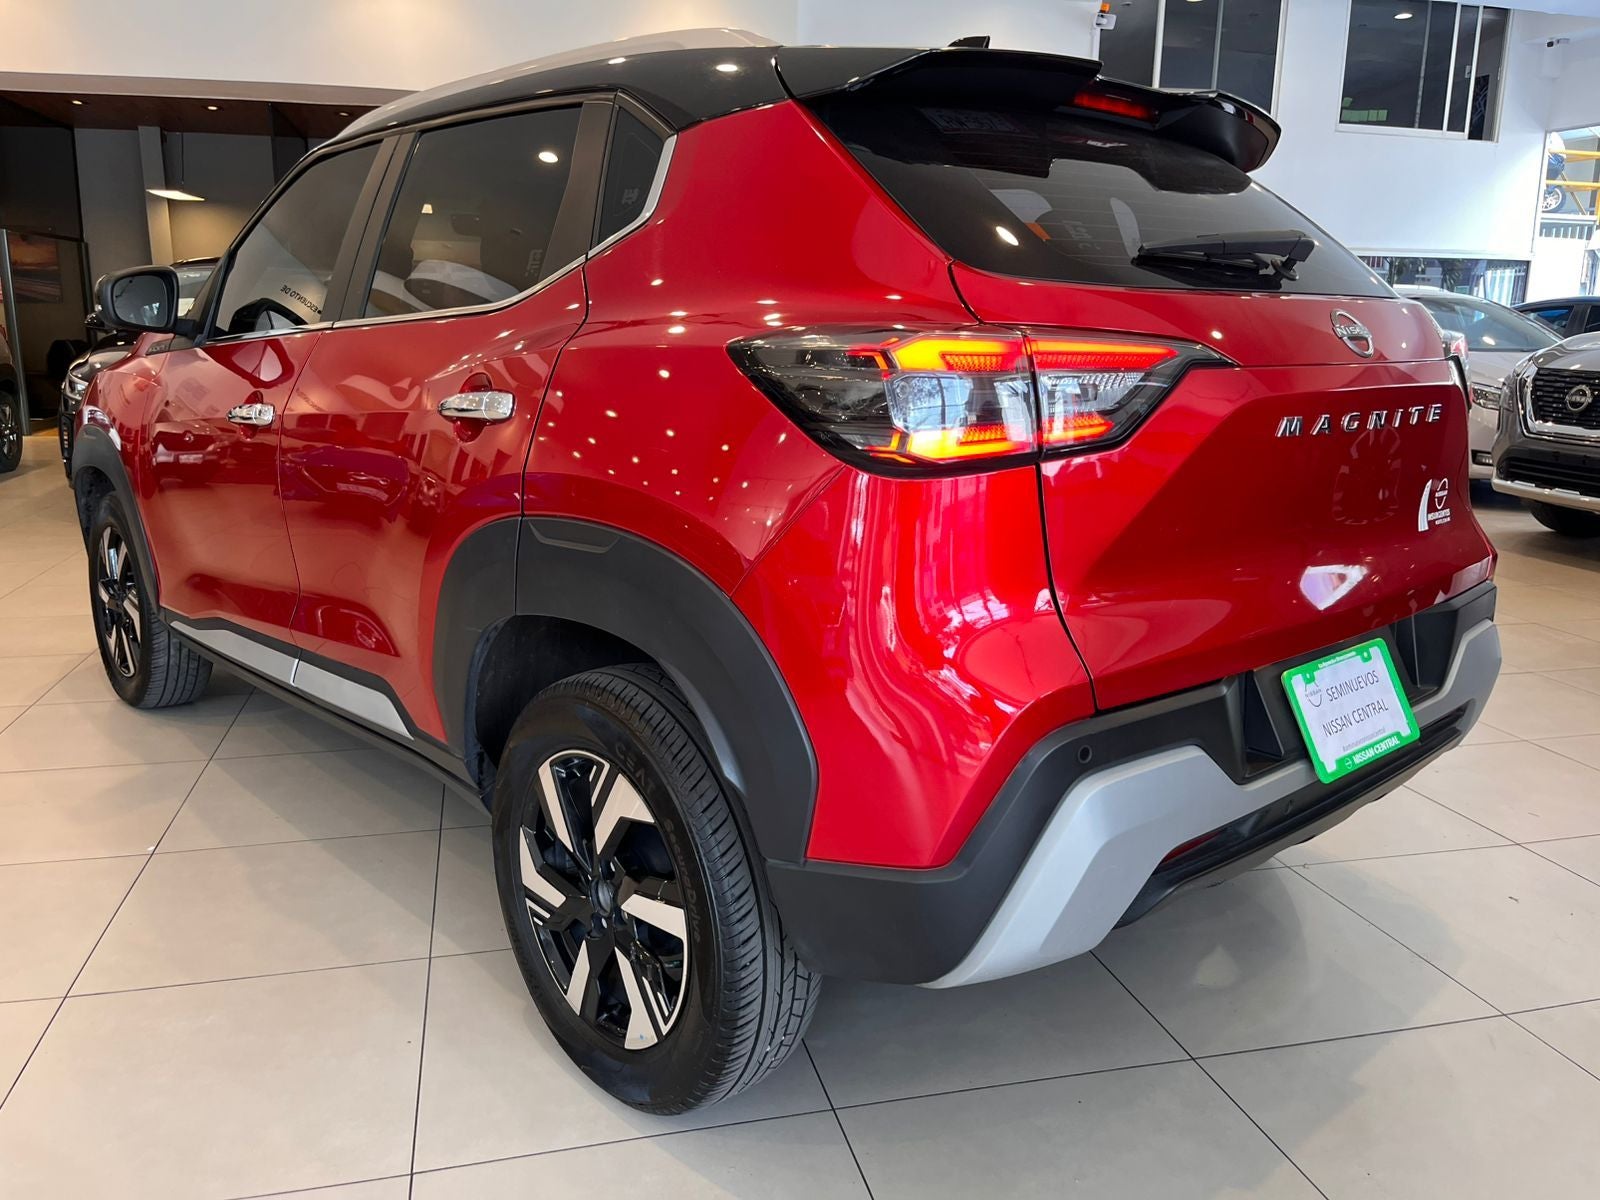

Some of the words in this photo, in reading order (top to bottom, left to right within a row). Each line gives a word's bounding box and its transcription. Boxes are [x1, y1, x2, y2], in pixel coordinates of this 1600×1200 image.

[1275, 403, 1442, 437] MAGNITE
[1325, 670, 1380, 702] SEMINUEVOS
[1322, 713, 1352, 738] NISSAN
[1352, 698, 1389, 726] CENTRAL
[1352, 746, 1375, 765] NISSAN
[1374, 735, 1401, 754] CENTRAL
[614, 741, 657, 794] CEAT
